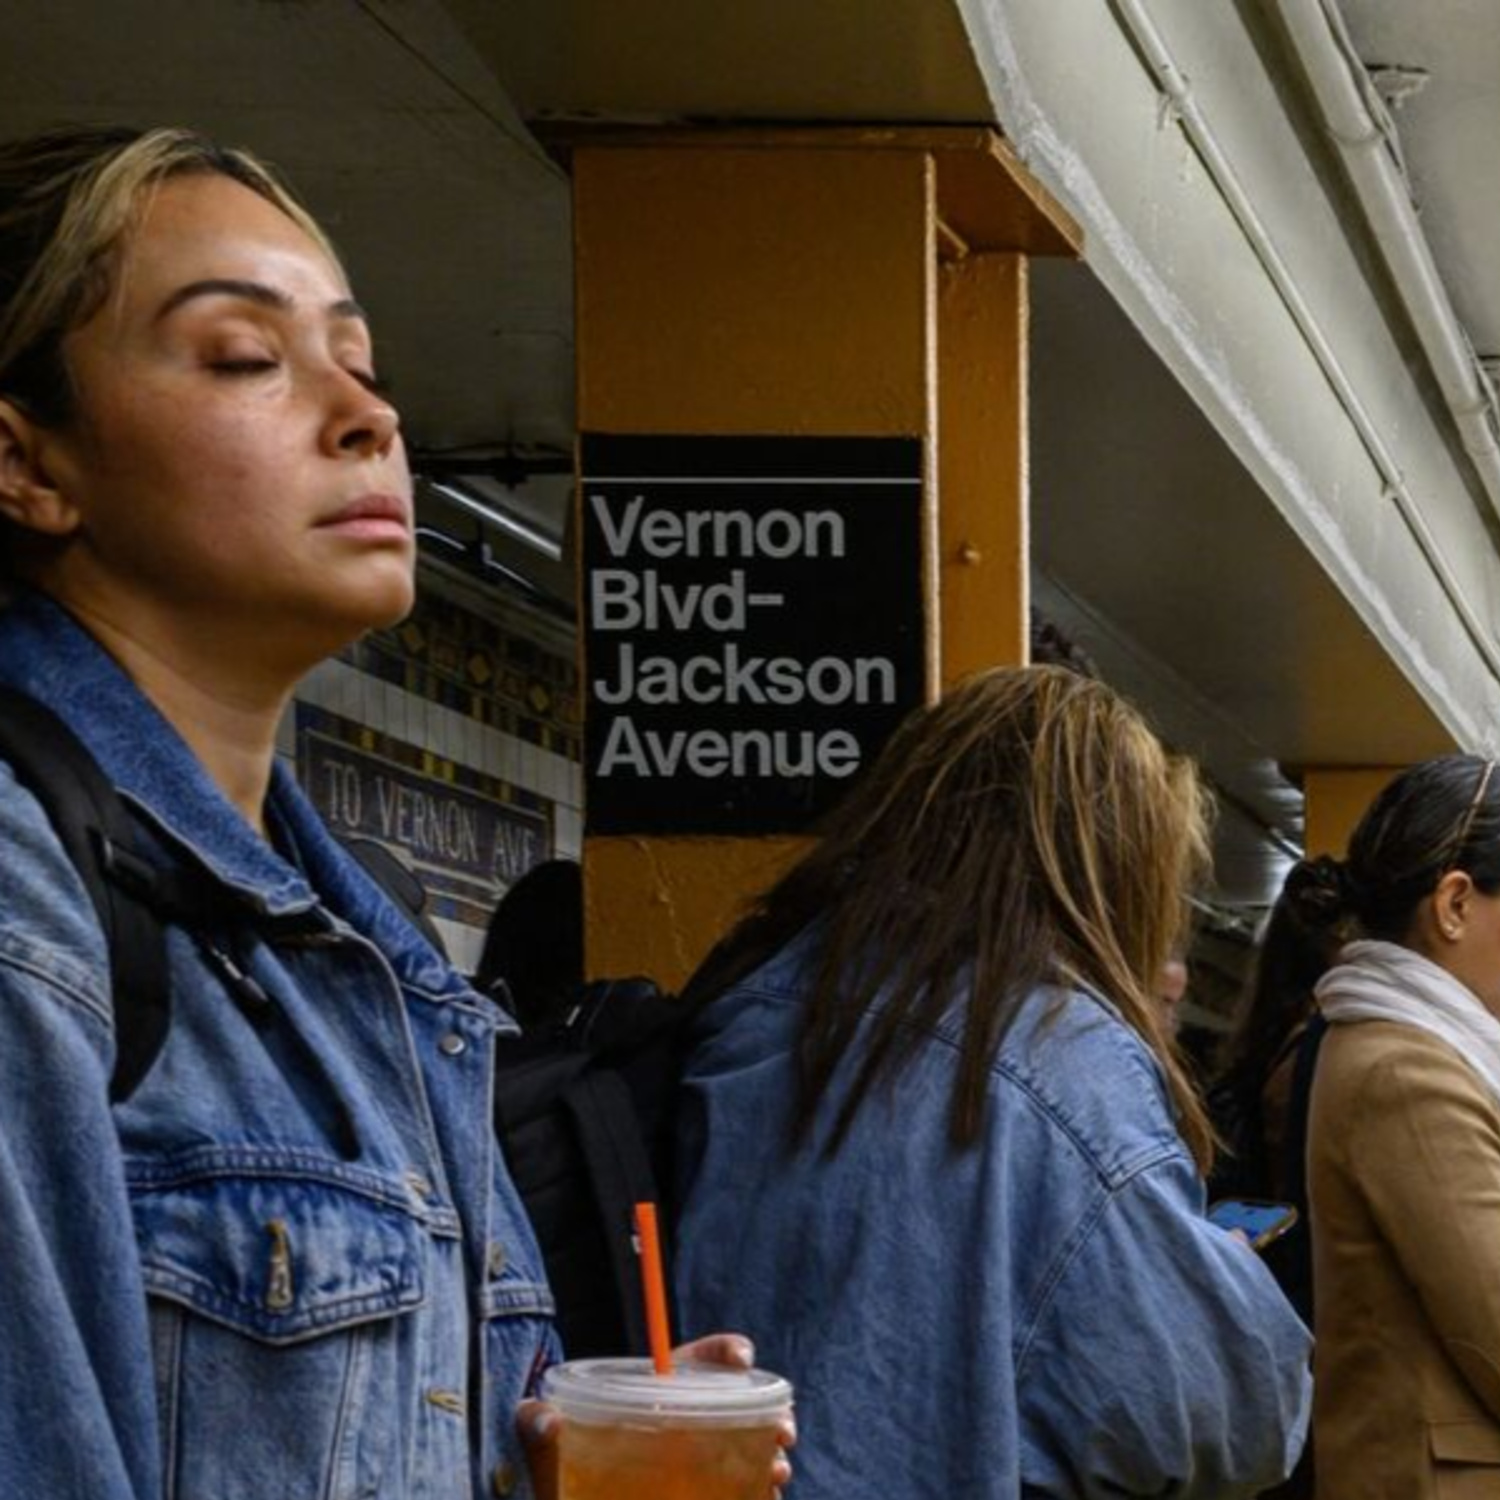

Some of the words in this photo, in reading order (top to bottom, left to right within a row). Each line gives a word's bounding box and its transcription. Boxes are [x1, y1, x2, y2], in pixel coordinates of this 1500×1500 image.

[589, 495, 846, 558] Vernon
[591, 569, 785, 630] Blvd-
[593, 643, 896, 704] Jackson
[596, 715, 862, 778] Avenue
[322, 759, 363, 828] TO
[375, 775, 479, 863] VERNON
